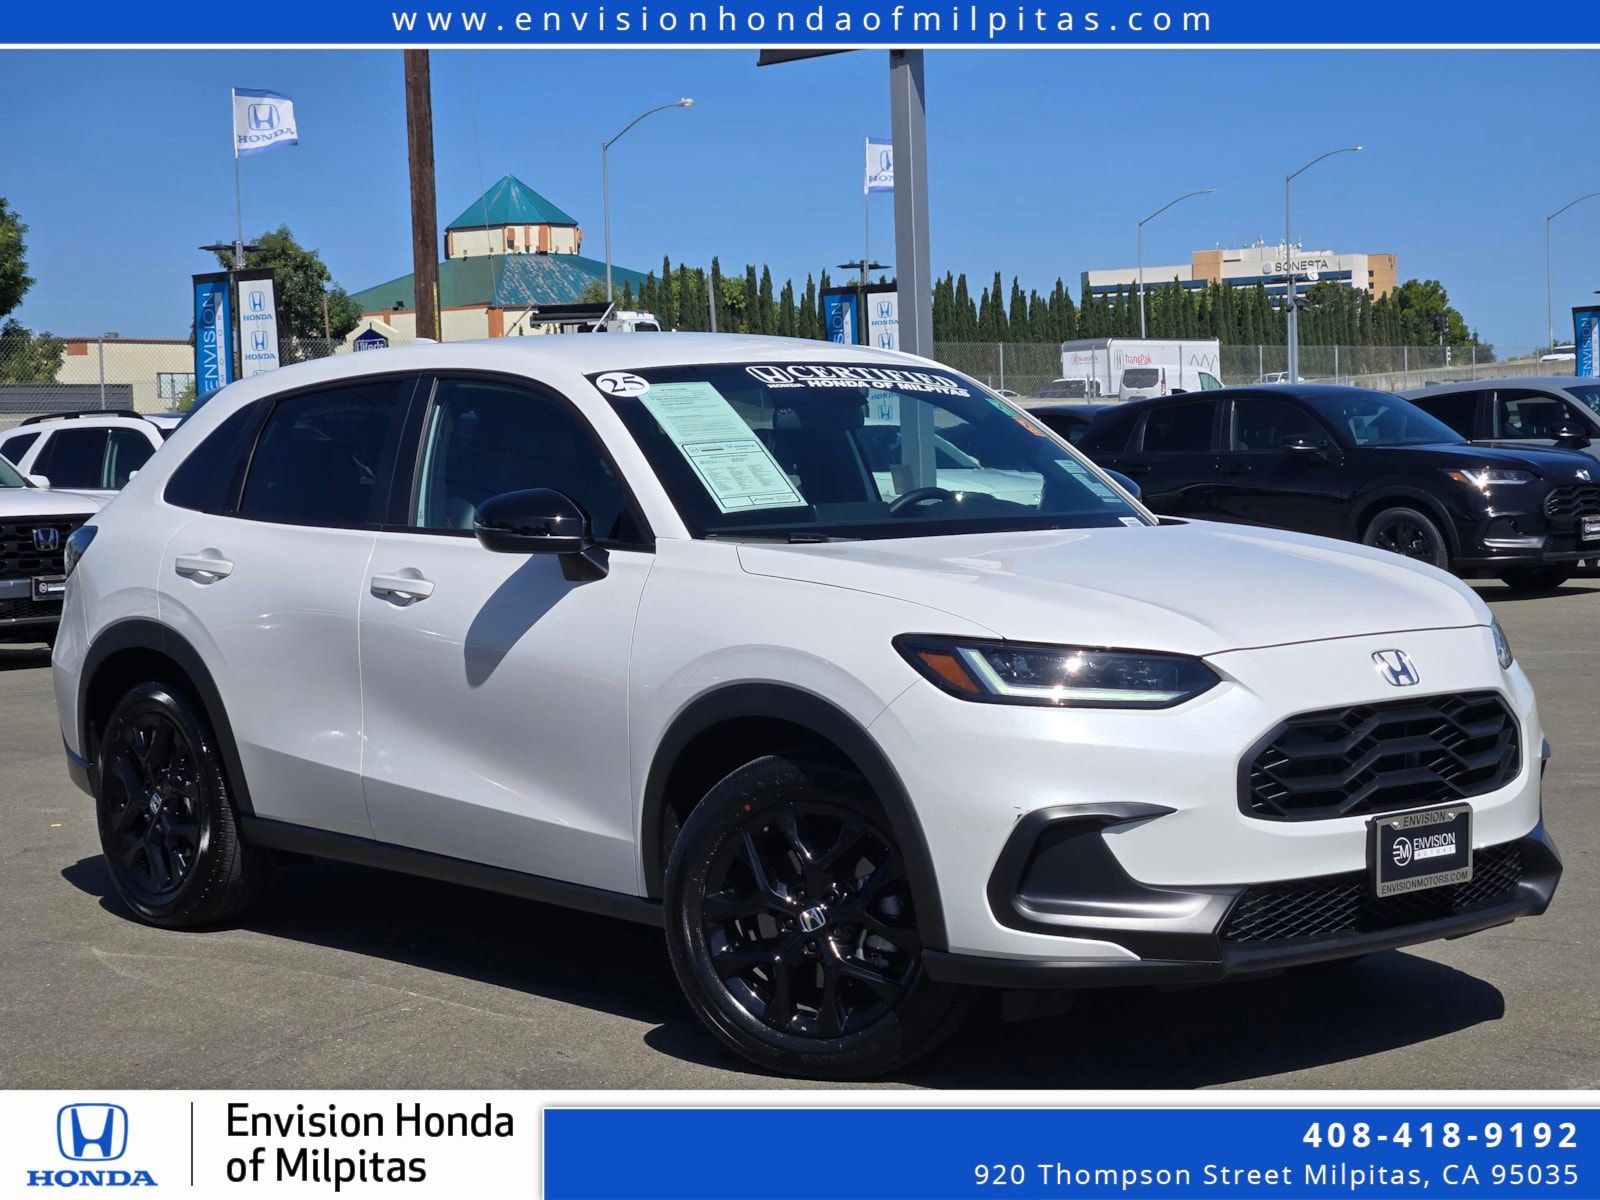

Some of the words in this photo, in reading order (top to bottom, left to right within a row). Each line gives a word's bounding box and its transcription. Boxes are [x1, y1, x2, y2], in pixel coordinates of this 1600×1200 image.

[237, 127, 295, 143] HONDA
[243, 313, 273, 321] HONDA
[203, 292, 219, 392] ENVISION
[245, 353, 276, 361] HONDA
[600, 375, 645, 393] 25
[786, 365, 959, 389] CERTIFIED
[807, 379, 870, 388] HONDA
[872, 380, 894, 389] OF
[897, 382, 971, 398] MILPITAS
[1403, 811, 1446, 828] ENVISION
[1413, 832, 1456, 851] ENVISION
[1381, 870, 1469, 896] ENVISIONMOTORS.COM
